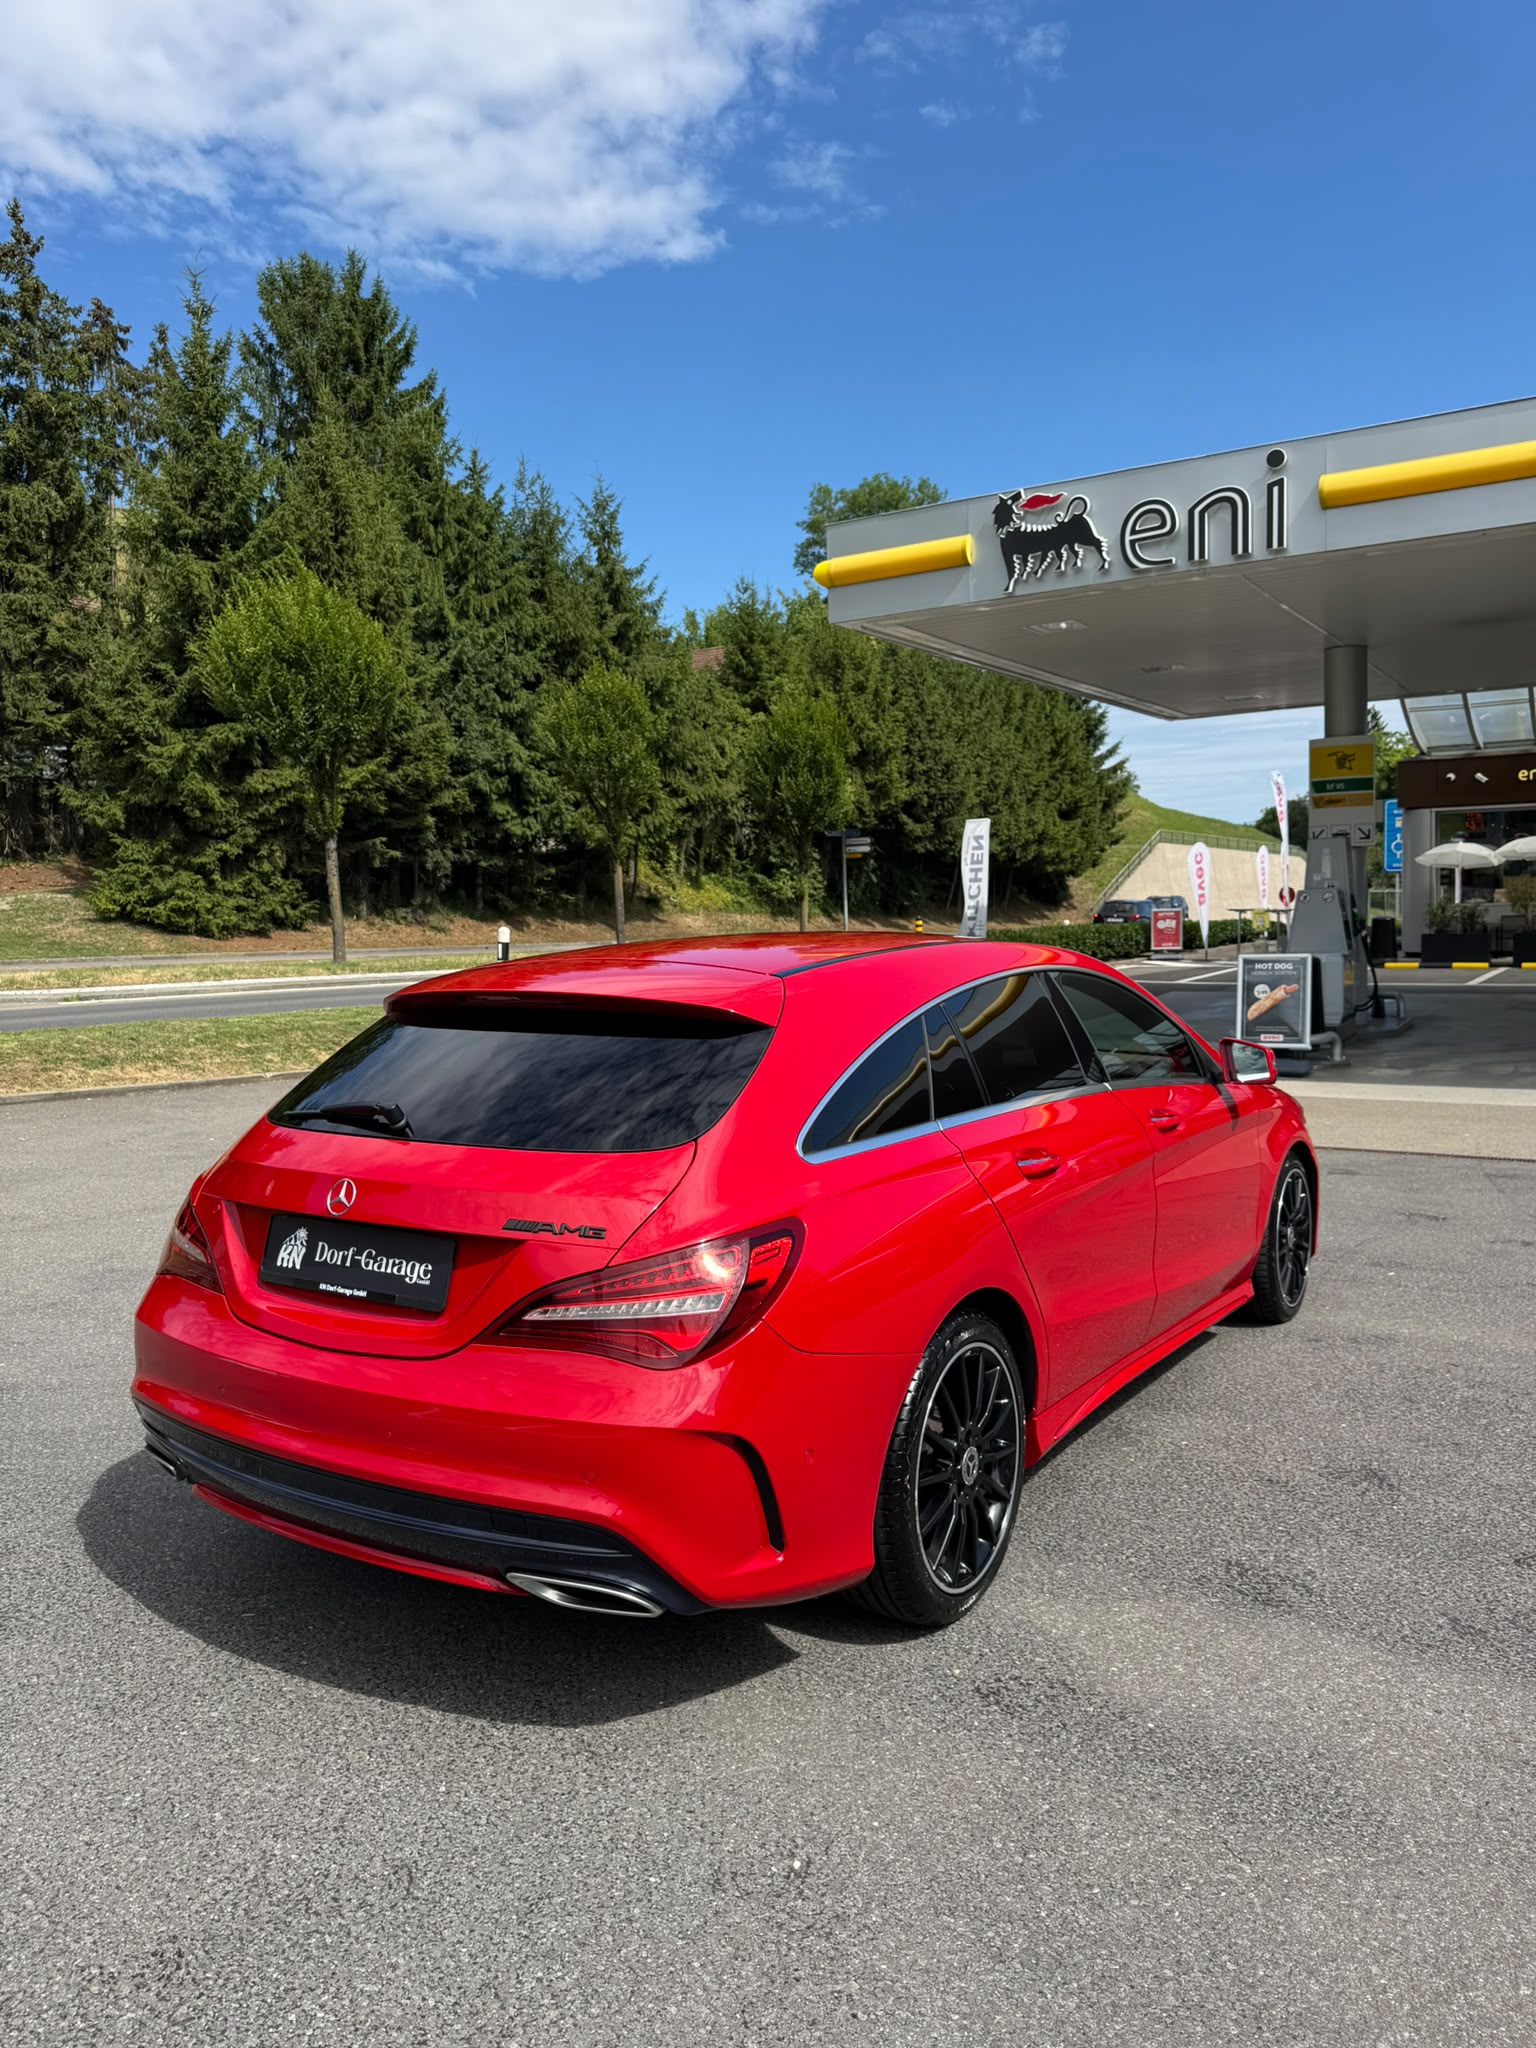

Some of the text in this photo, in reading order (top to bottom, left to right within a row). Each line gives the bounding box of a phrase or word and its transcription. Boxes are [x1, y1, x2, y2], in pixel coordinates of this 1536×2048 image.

[1119, 448, 1288, 569] eni
[533, 1221, 607, 1240] AMG
[276, 1244, 307, 1270] KN
[314, 1241, 432, 1284] Dorf-Garage
[326, 1283, 353, 1297] Dorf-Garage
[353, 1289, 368, 1298] GmbH
